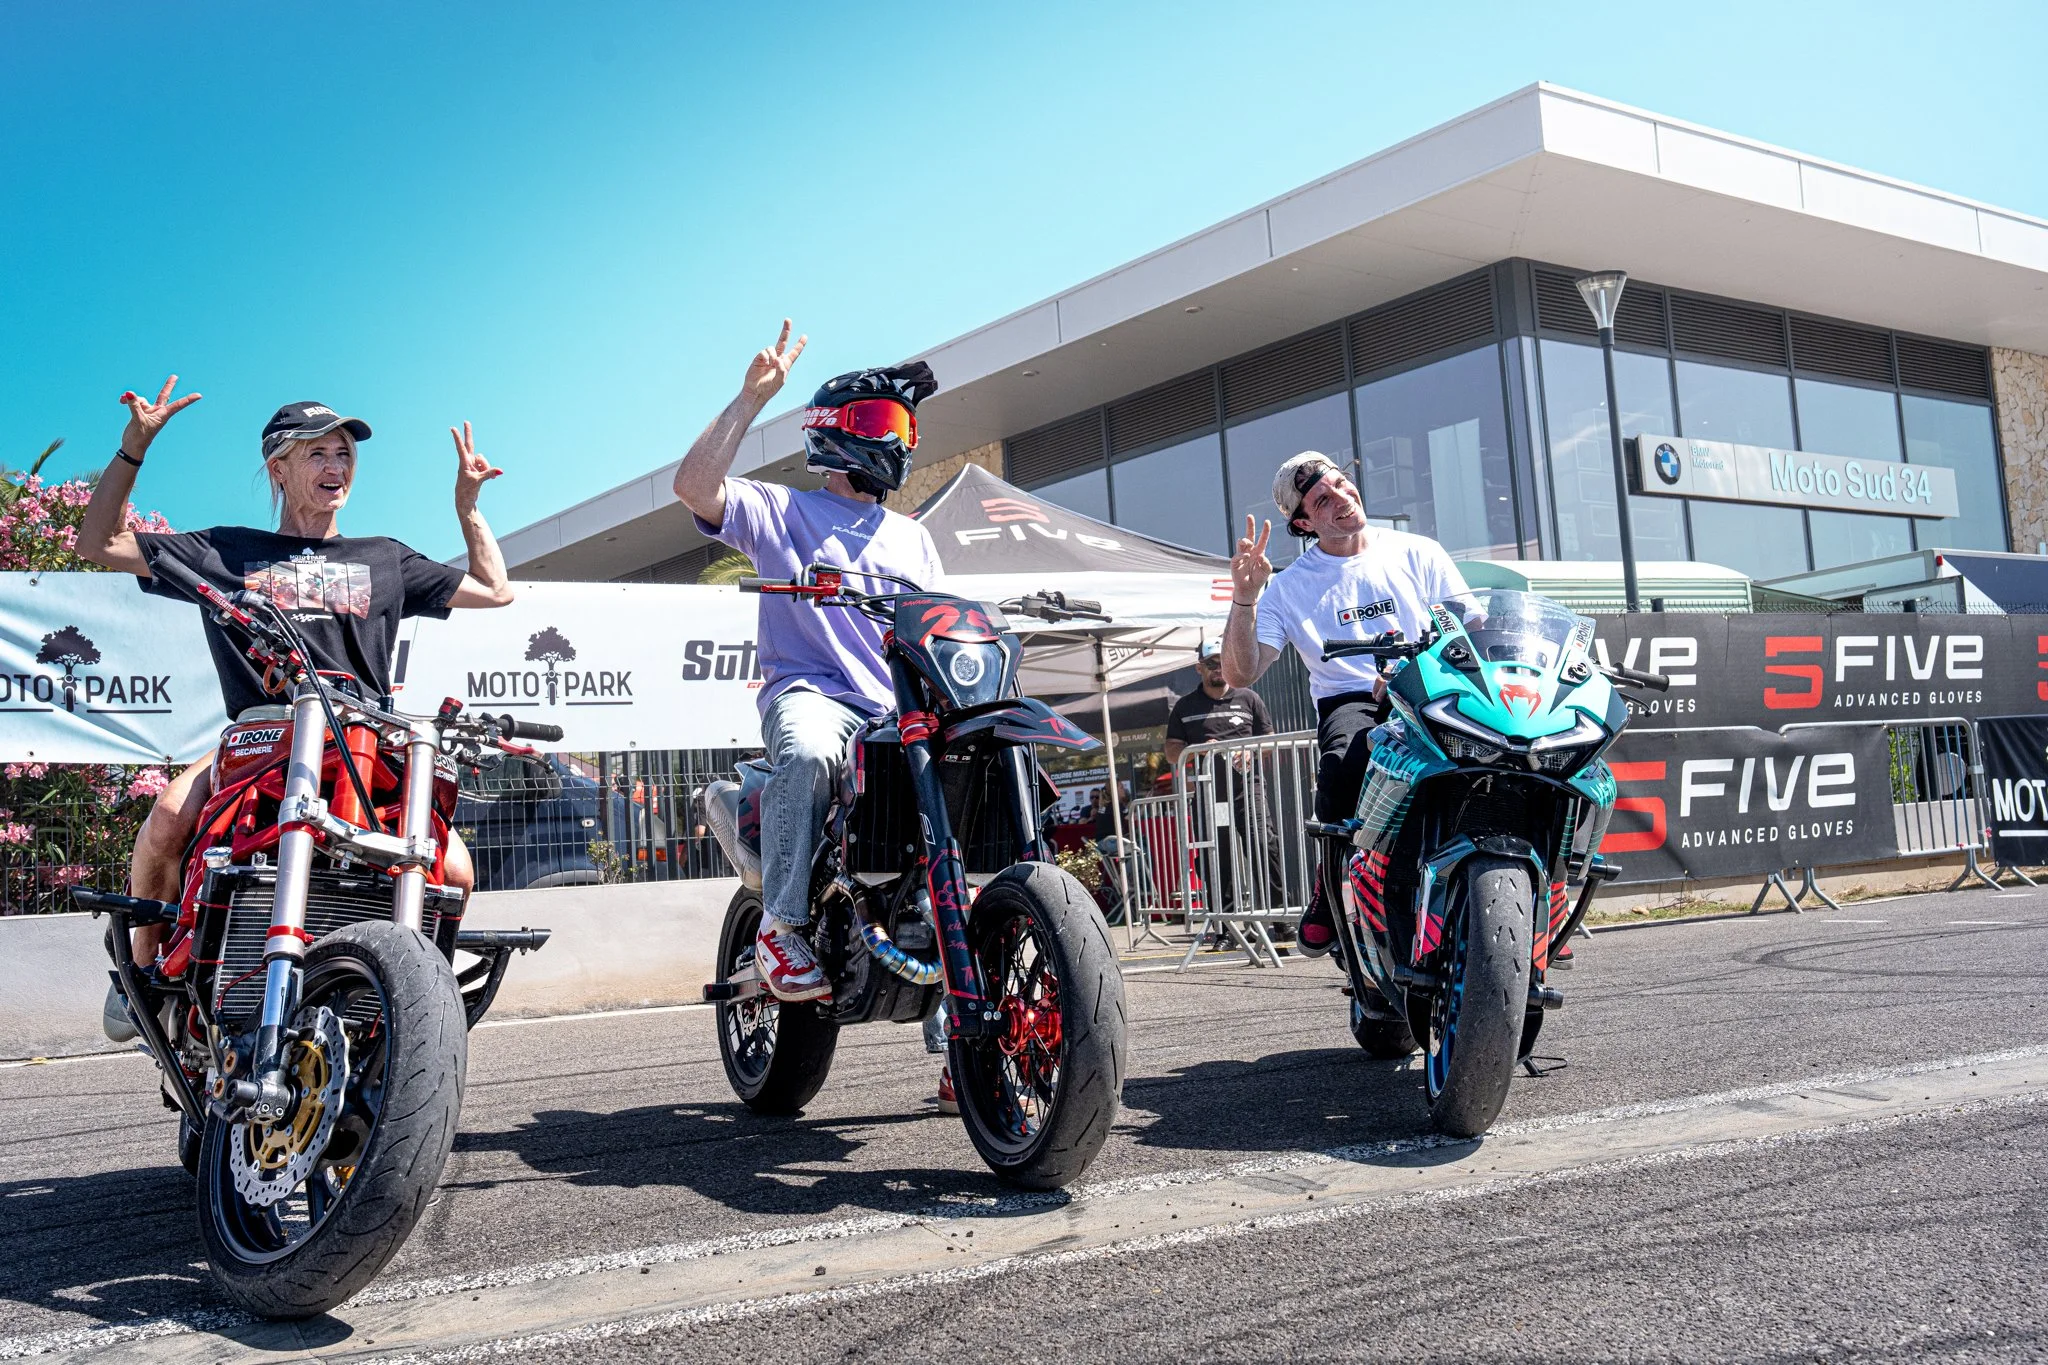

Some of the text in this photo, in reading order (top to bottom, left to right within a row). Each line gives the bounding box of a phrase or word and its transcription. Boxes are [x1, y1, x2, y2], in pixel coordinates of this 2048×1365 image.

[1691, 446, 1710, 457] BMW
[1692, 460, 1724, 471] Motorrad
[1769, 452, 1932, 505] Moto Sud 34
[1352, 601, 1393, 620] IPONE
[1434, 608, 1456, 634] IPONE
[1576, 622, 1591, 645] IPONE
[1594, 637, 1698, 688] VE
[1835, 635, 1984, 682] FIVE
[0, 674, 172, 704] OTO PARK
[468, 671, 633, 697] MOTO PARK
[1834, 690, 1983, 708] ADVANCED GLOVES
[239, 729, 282, 744] IPONE
[235, 745, 273, 757] BECANERIE
[434, 754, 458, 774] PONE
[1050, 771, 1072, 780] COURSE
[1680, 752, 1856, 817] FIVE
[1992, 778, 2048, 822] MOT
[1681, 819, 1854, 849] ADVANCED GLOVES
